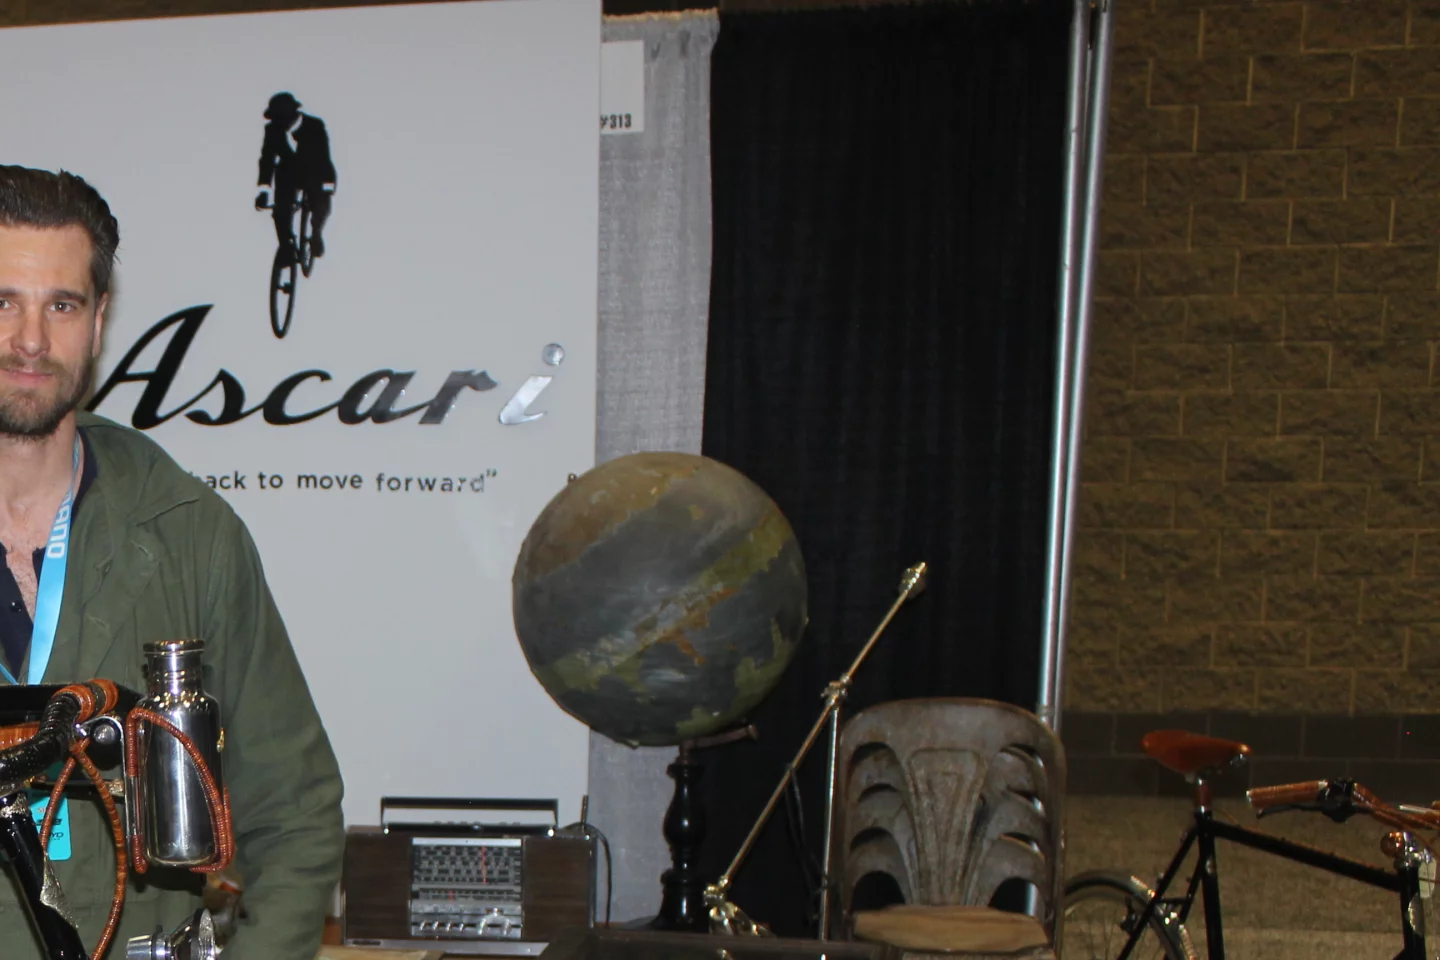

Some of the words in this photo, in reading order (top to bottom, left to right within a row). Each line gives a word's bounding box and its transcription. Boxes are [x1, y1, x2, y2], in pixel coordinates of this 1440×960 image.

[86, 303, 566, 431] Ascari
[258, 471, 284, 490] to
[297, 474, 364, 490] move
